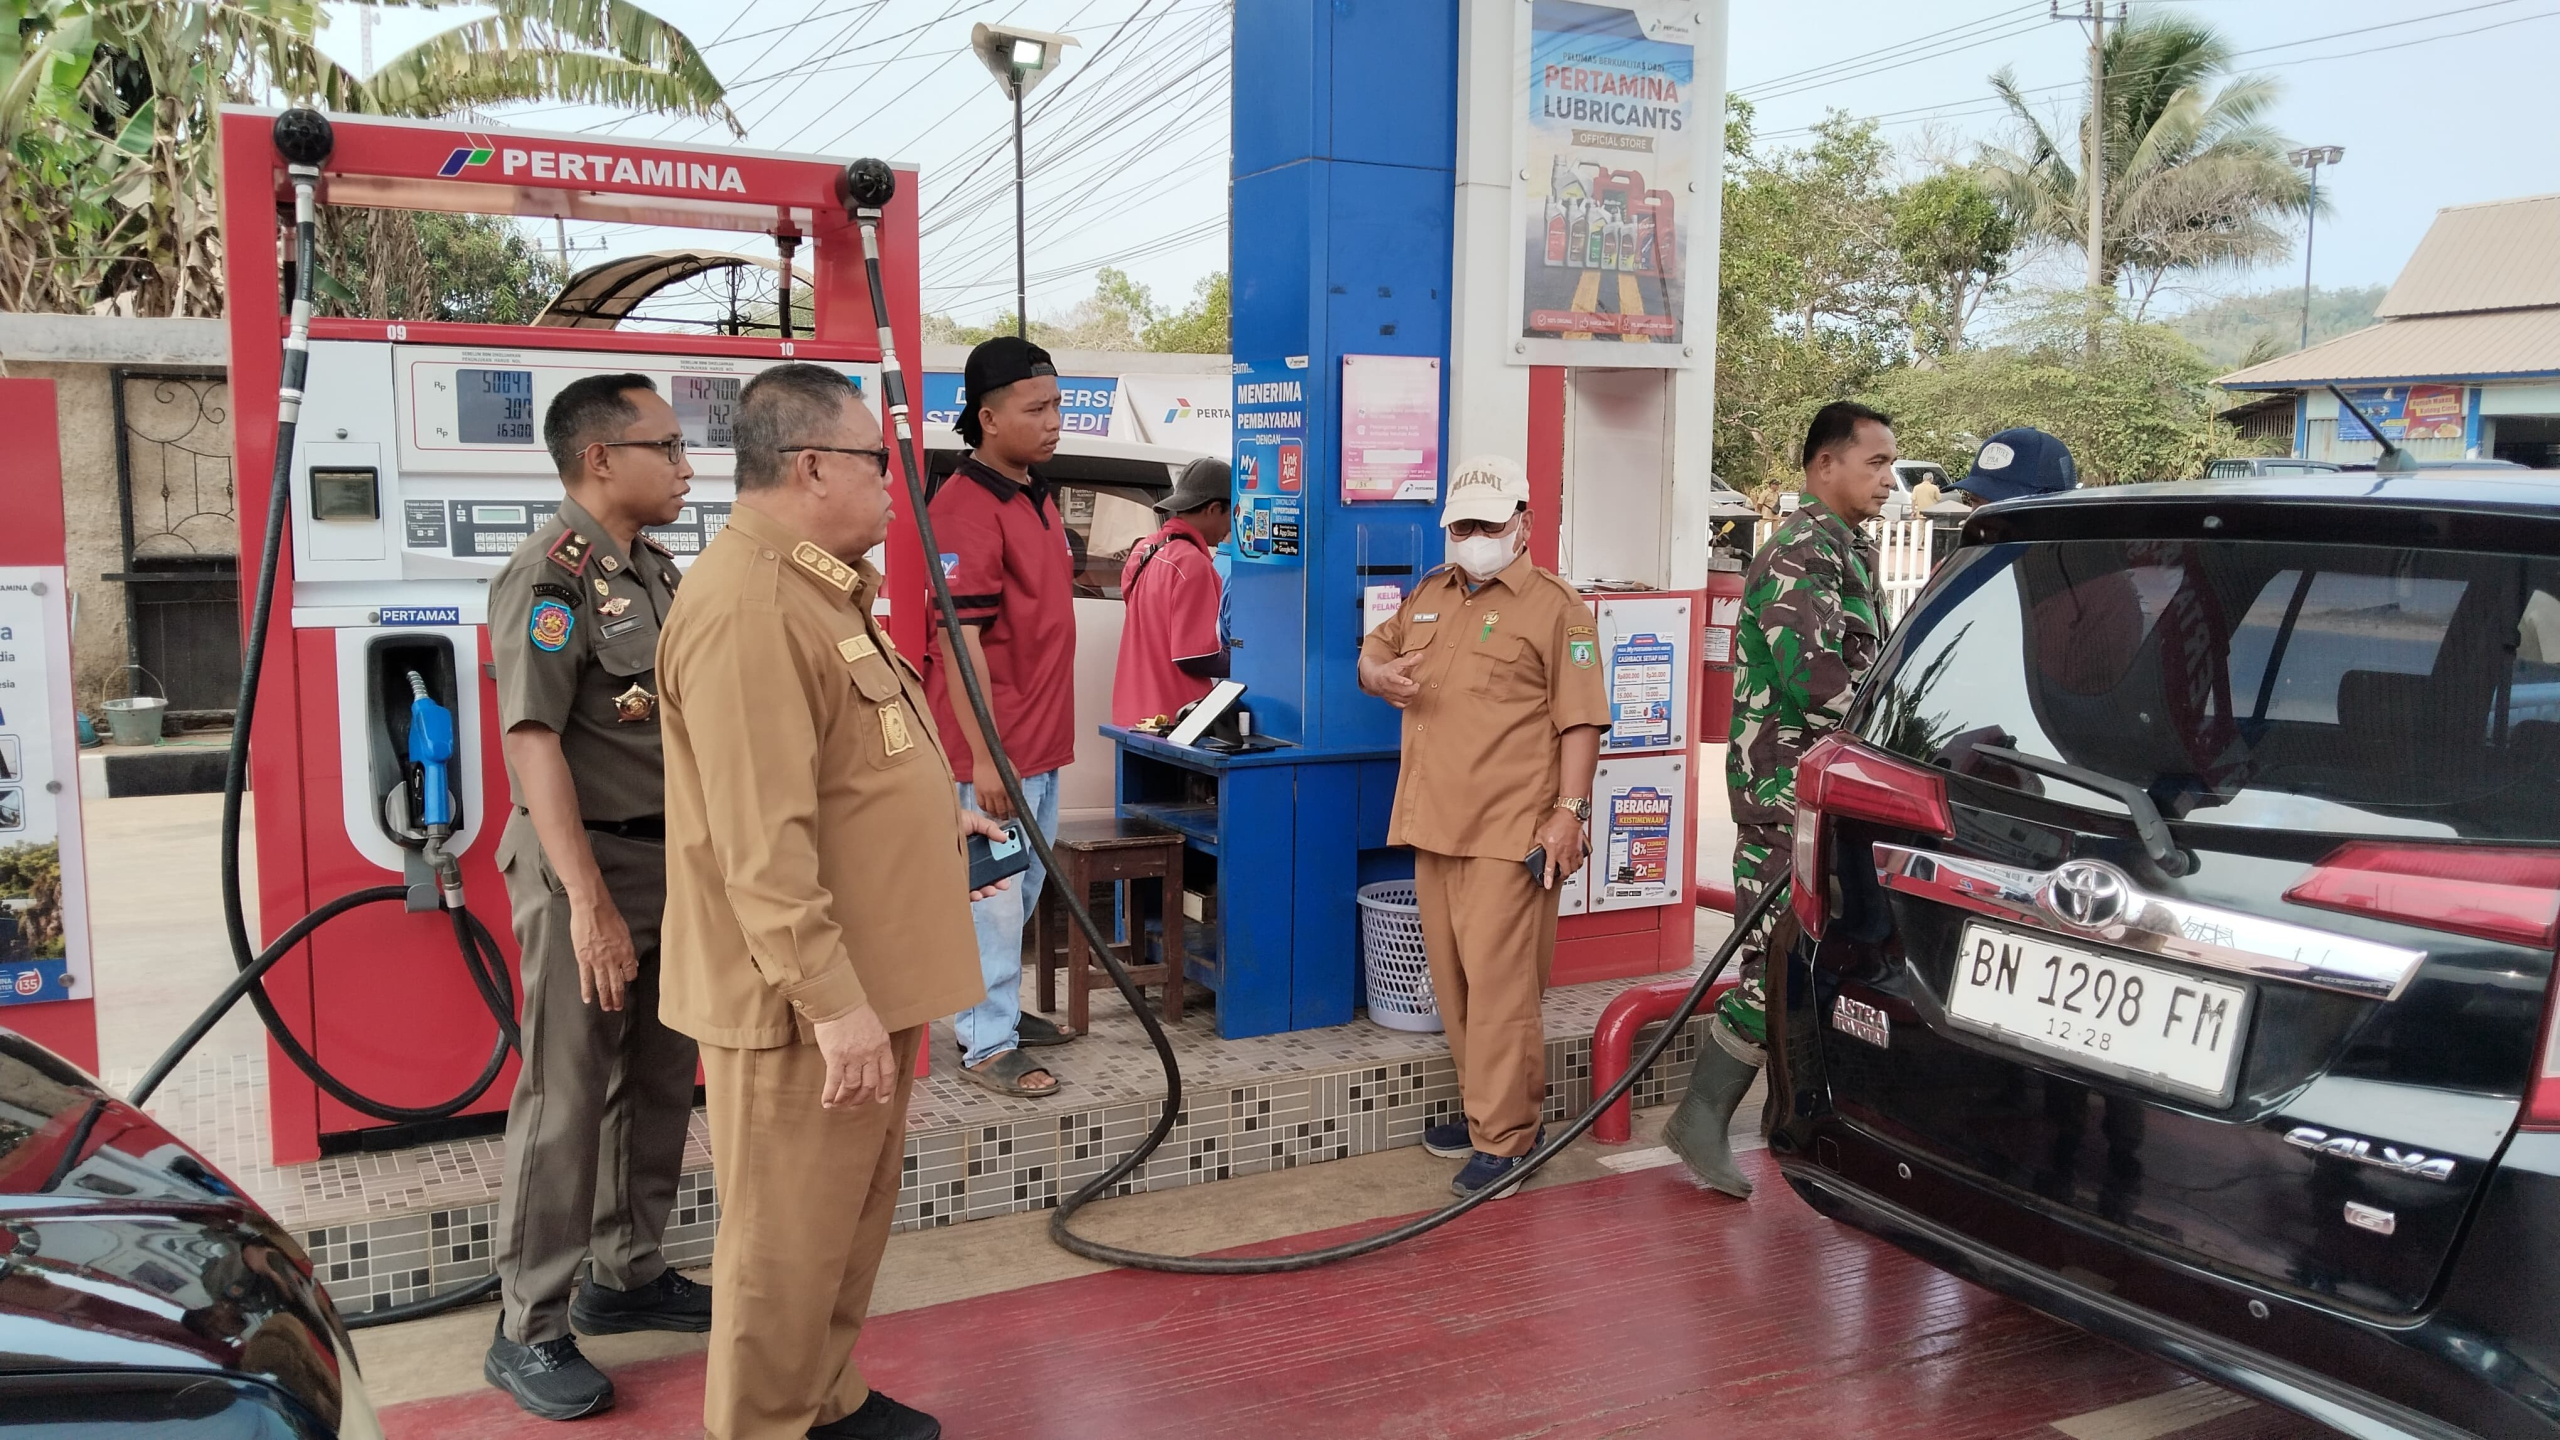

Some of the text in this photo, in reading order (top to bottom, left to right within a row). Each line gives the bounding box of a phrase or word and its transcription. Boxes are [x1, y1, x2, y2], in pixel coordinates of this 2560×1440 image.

[1563, 52, 1665, 73] PELUMAS BERKUALITAS DARI
[1544, 64, 1679, 103] PERTAMINA
[1544, 95, 1682, 131] LUBRICANTS
[1580, 133, 1646, 149] OFFICIAL STORE
[503, 149, 746, 194] PERTAMINA
[387, 325, 407, 341] 09
[779, 342, 794, 356] 10
[483, 371, 531, 393] 50041
[689, 379, 738, 400] 142400
[1238, 381, 1302, 404] MENERIMA
[1238, 411, 1301, 429] PEMBAYARAN
[497, 424, 532, 437] 16300
[1255, 434, 1281, 445] DENGAN
[1240, 453, 1297, 474] My Link
[1283, 464, 1296, 478] Aja!
[1450, 470, 1502, 498] MIAMI
[1279, 529, 1297, 537] App Store
[1279, 546, 1291, 554] Google
[382, 610, 456, 621] PERTAMAX
[1618, 655, 1642, 663] CASHBACK
[1643, 654, 1657, 662] SETIAP
[1615, 799, 1669, 814] BERAGAM
[1619, 816, 1664, 824] KEISTIMEWAAN
[1632, 841, 1646, 856] 8%
[19, 979, 37, 991] 135
[1970, 938, 2230, 1052] BN 1298 FM
[1834, 995, 1889, 1031] ASTRA
[1833, 1015, 1889, 1048] TOYOTA
[2283, 1127, 2456, 1181] CALYA
